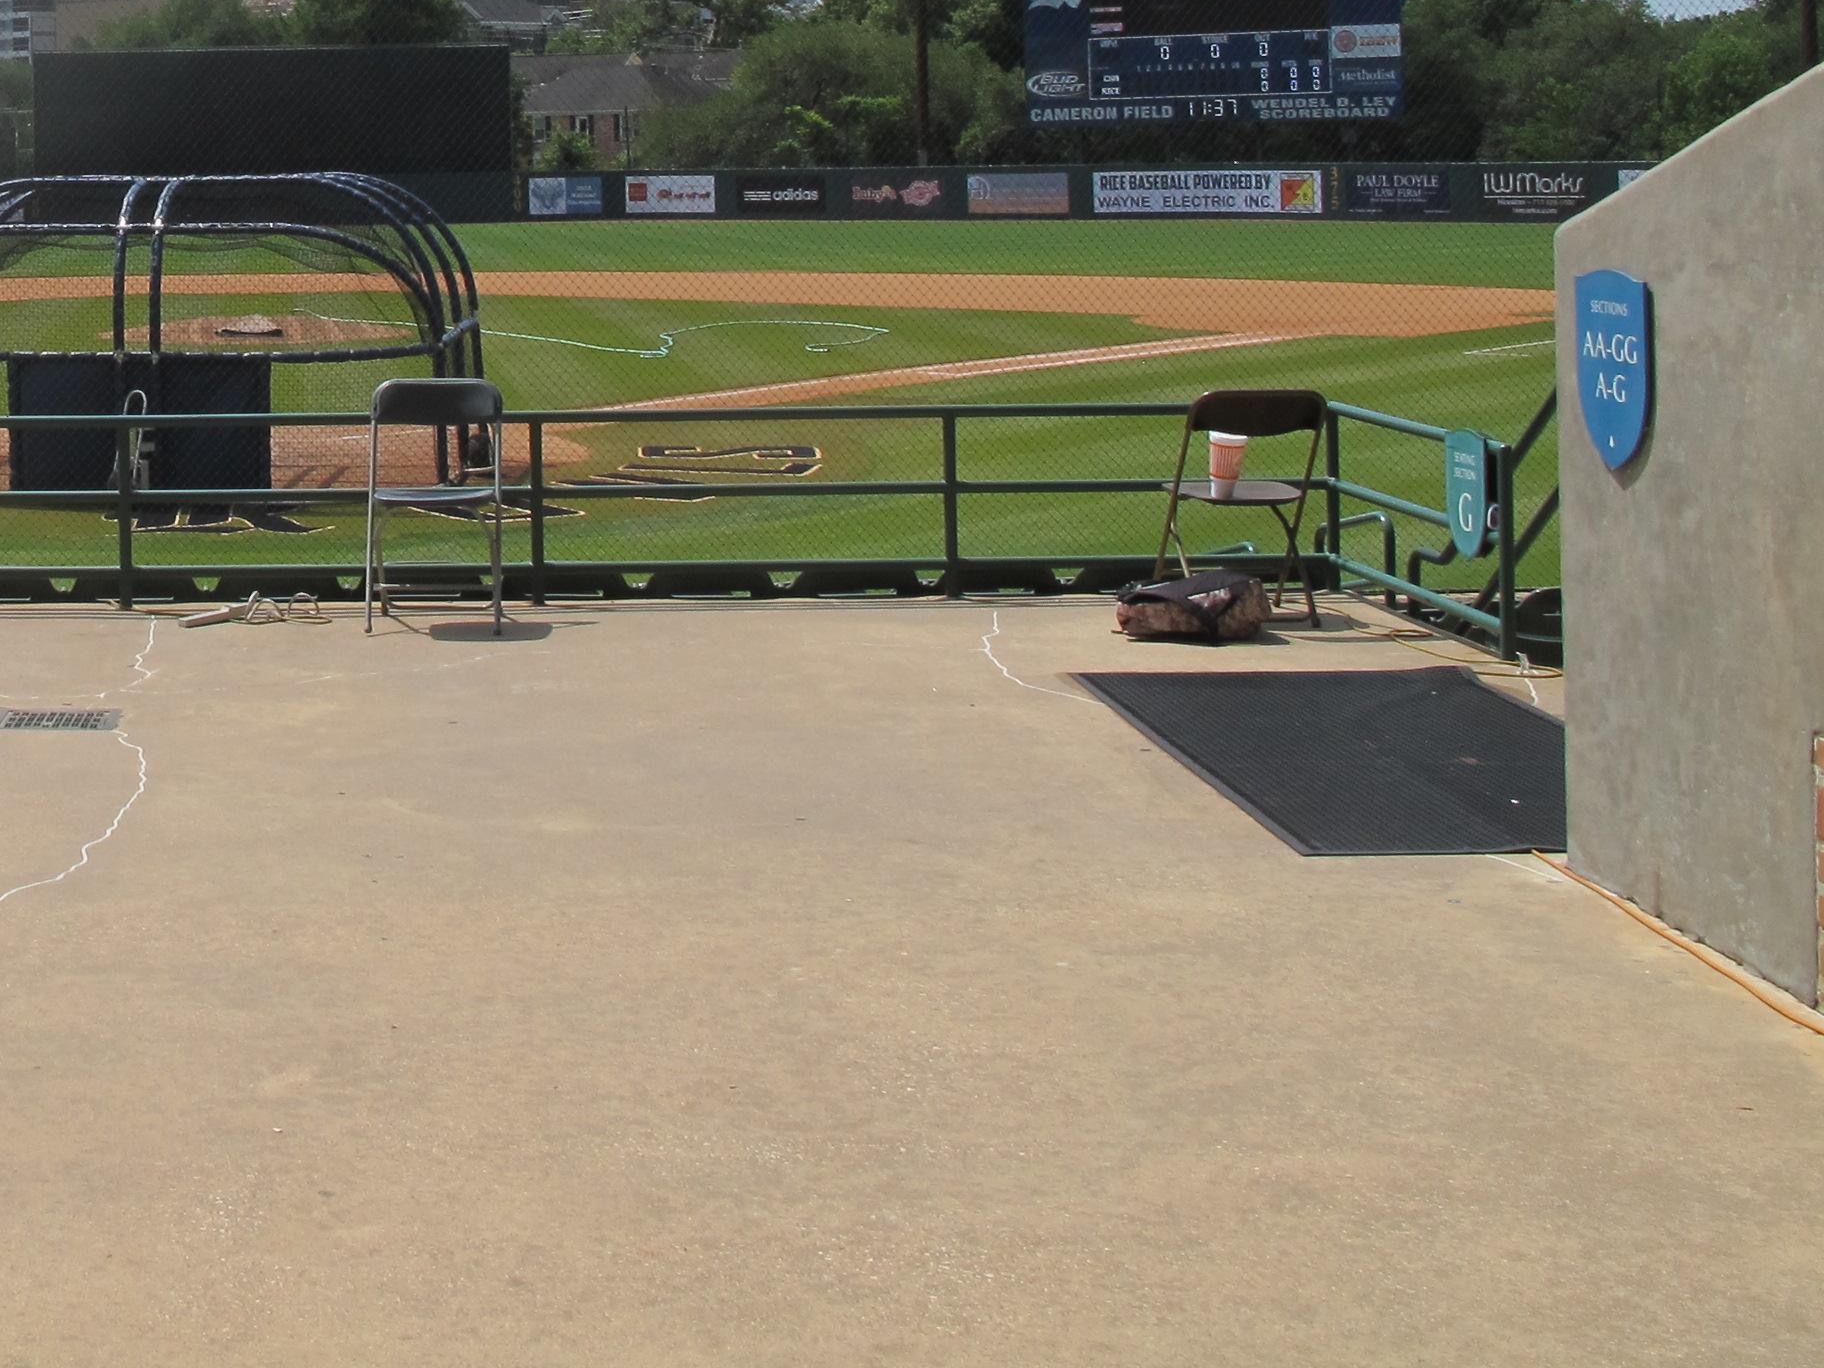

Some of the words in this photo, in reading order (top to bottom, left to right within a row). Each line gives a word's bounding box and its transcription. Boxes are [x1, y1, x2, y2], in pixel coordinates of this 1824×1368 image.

[1251, 97, 1329, 109] WENDEL
[1362, 96, 1397, 107] LEY
[1030, 107, 1118, 122] CAMERON
[1124, 105, 1173, 119] FIELD
[1259, 107, 1390, 120] SCOREBOARD
[1099, 175, 1127, 191] RICE
[1128, 174, 1191, 191] BASEBALL
[1193, 174, 1253, 190] POWERED
[1254, 174, 1271, 189] BY
[1356, 175, 1391, 187] PAUL
[1393, 174, 1440, 187] DOYLE
[772, 187, 819, 201] adidas
[1374, 188, 1394, 197] LAW
[1397, 188, 1422, 197] FIRM
[1098, 195, 1151, 208] WAYNE
[1163, 195, 1236, 208] ELECTRIC
[1245, 195, 1274, 208] INC.
[1590, 299, 1629, 317] SECTIONS
[1583, 330, 1638, 364] AA-GG
[1595, 371, 1626, 403] A-G
[1458, 492, 1473, 532] G
